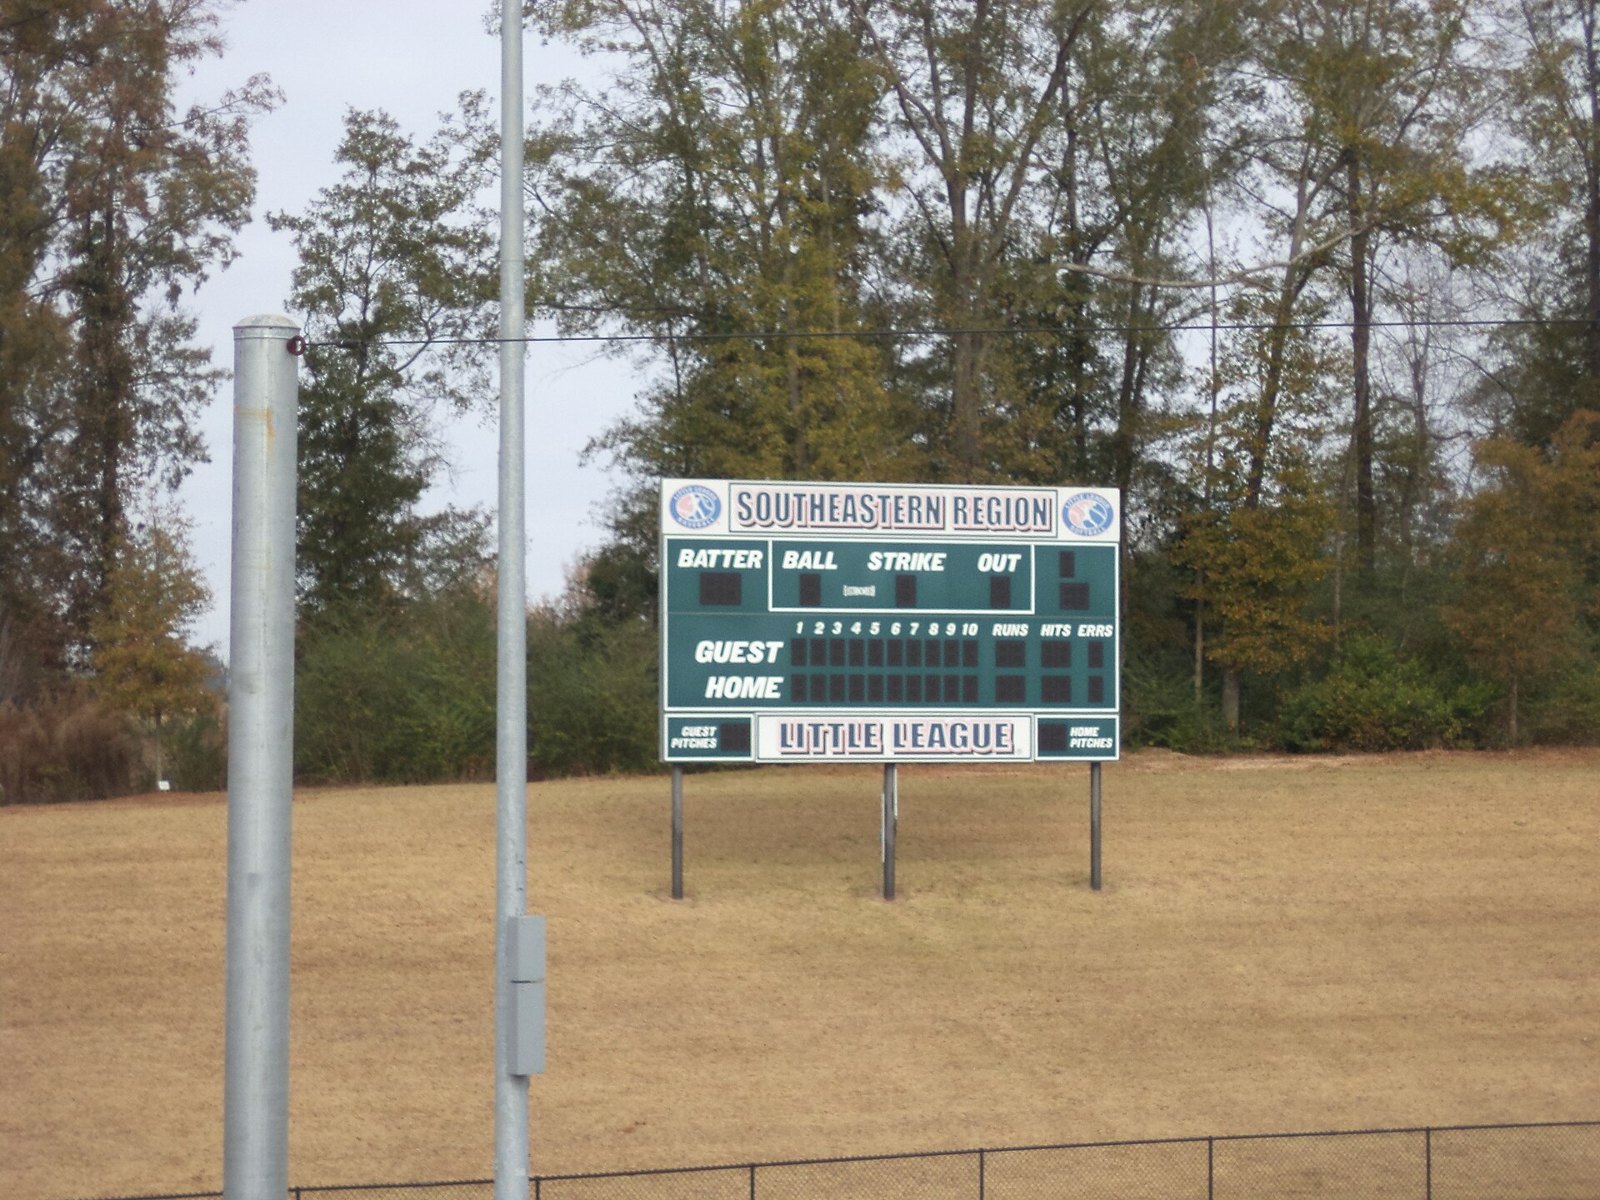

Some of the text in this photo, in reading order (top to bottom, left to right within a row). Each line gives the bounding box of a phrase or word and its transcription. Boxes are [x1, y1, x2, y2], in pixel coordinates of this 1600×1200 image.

[737, 491, 945, 529] SOUTHEASTERN
[953, 496, 1052, 531] REGION
[677, 549, 763, 569] BATTER
[782, 551, 1022, 573] BALL STRIKE OUT
[795, 621, 1113, 637] 1 2 3 4 5 6 7 8 9 10 RUNS HITS ERRS
[695, 640, 784, 664] GUEST
[705, 676, 784, 699] HOME
[681, 725, 717, 737] GUEST
[780, 723, 1014, 755] LITTLE LEAGUE
[1070, 726, 1099, 738] HOME
[671, 738, 717, 750] PITCHES
[1070, 738, 1113, 750] PITCHES
